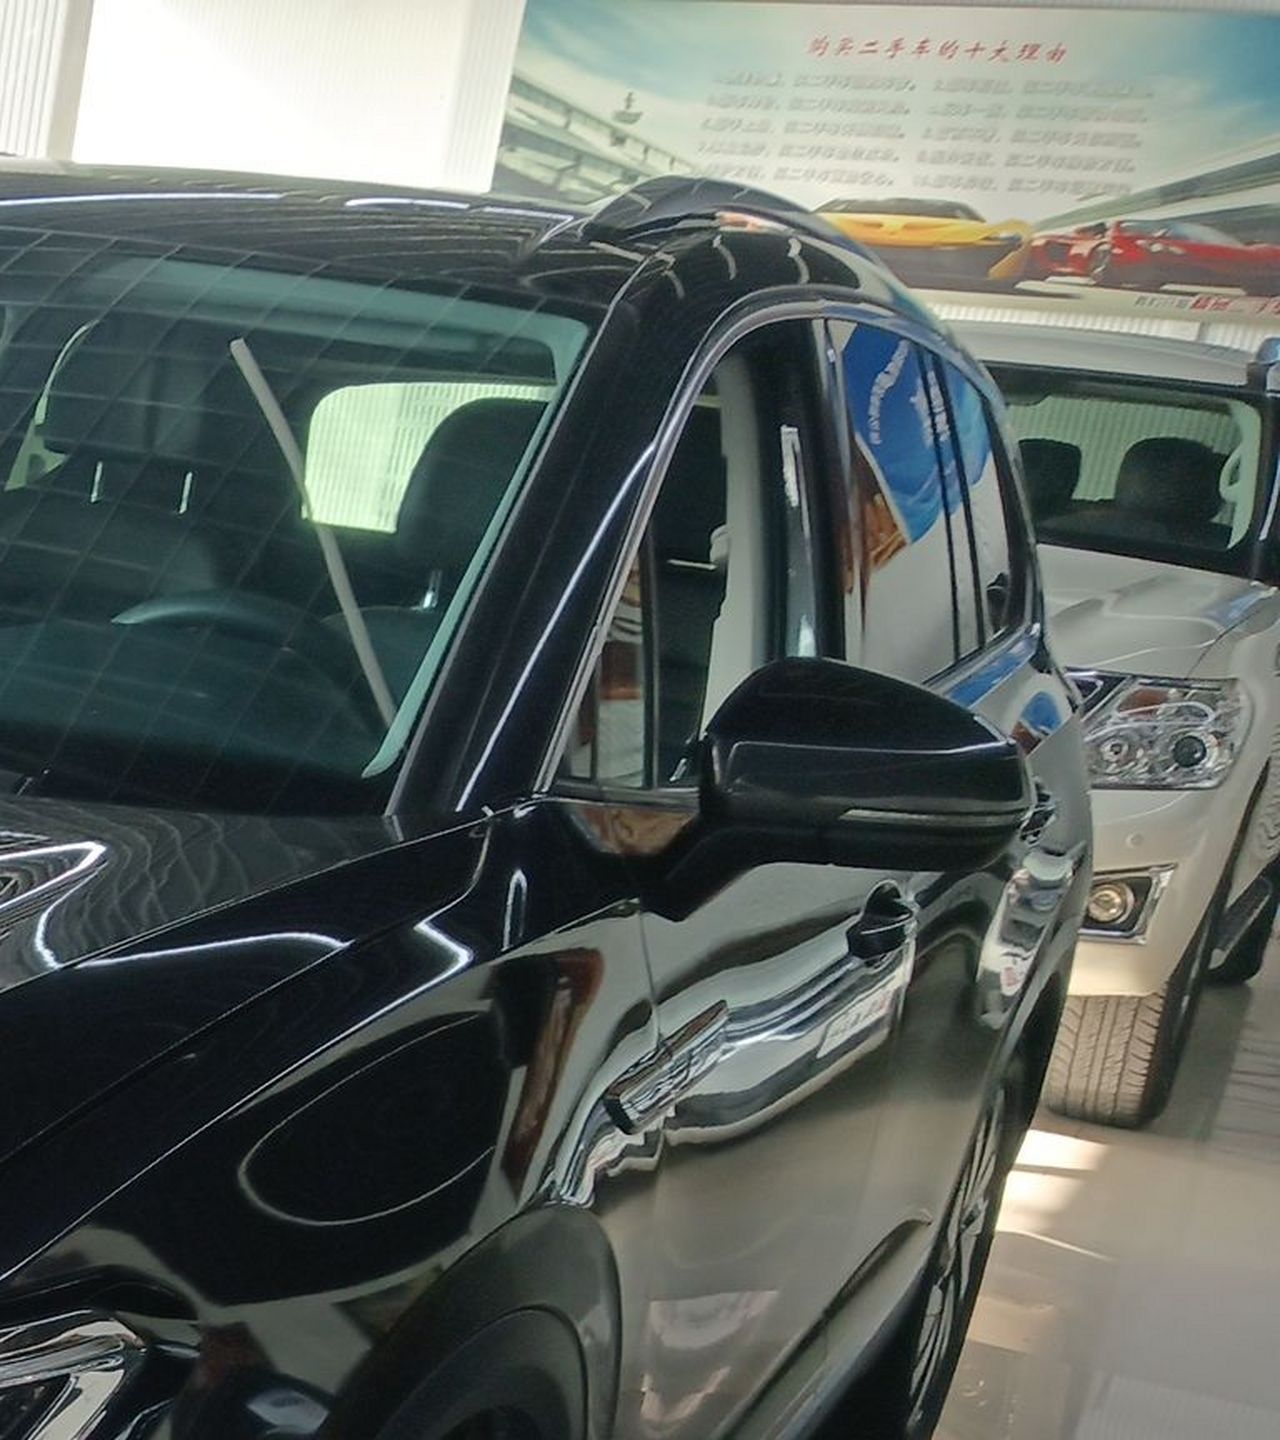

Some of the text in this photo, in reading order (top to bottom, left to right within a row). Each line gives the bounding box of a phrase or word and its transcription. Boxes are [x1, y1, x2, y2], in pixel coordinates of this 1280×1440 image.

[809, 35, 1068, 64] 购买二手车的十大理由
